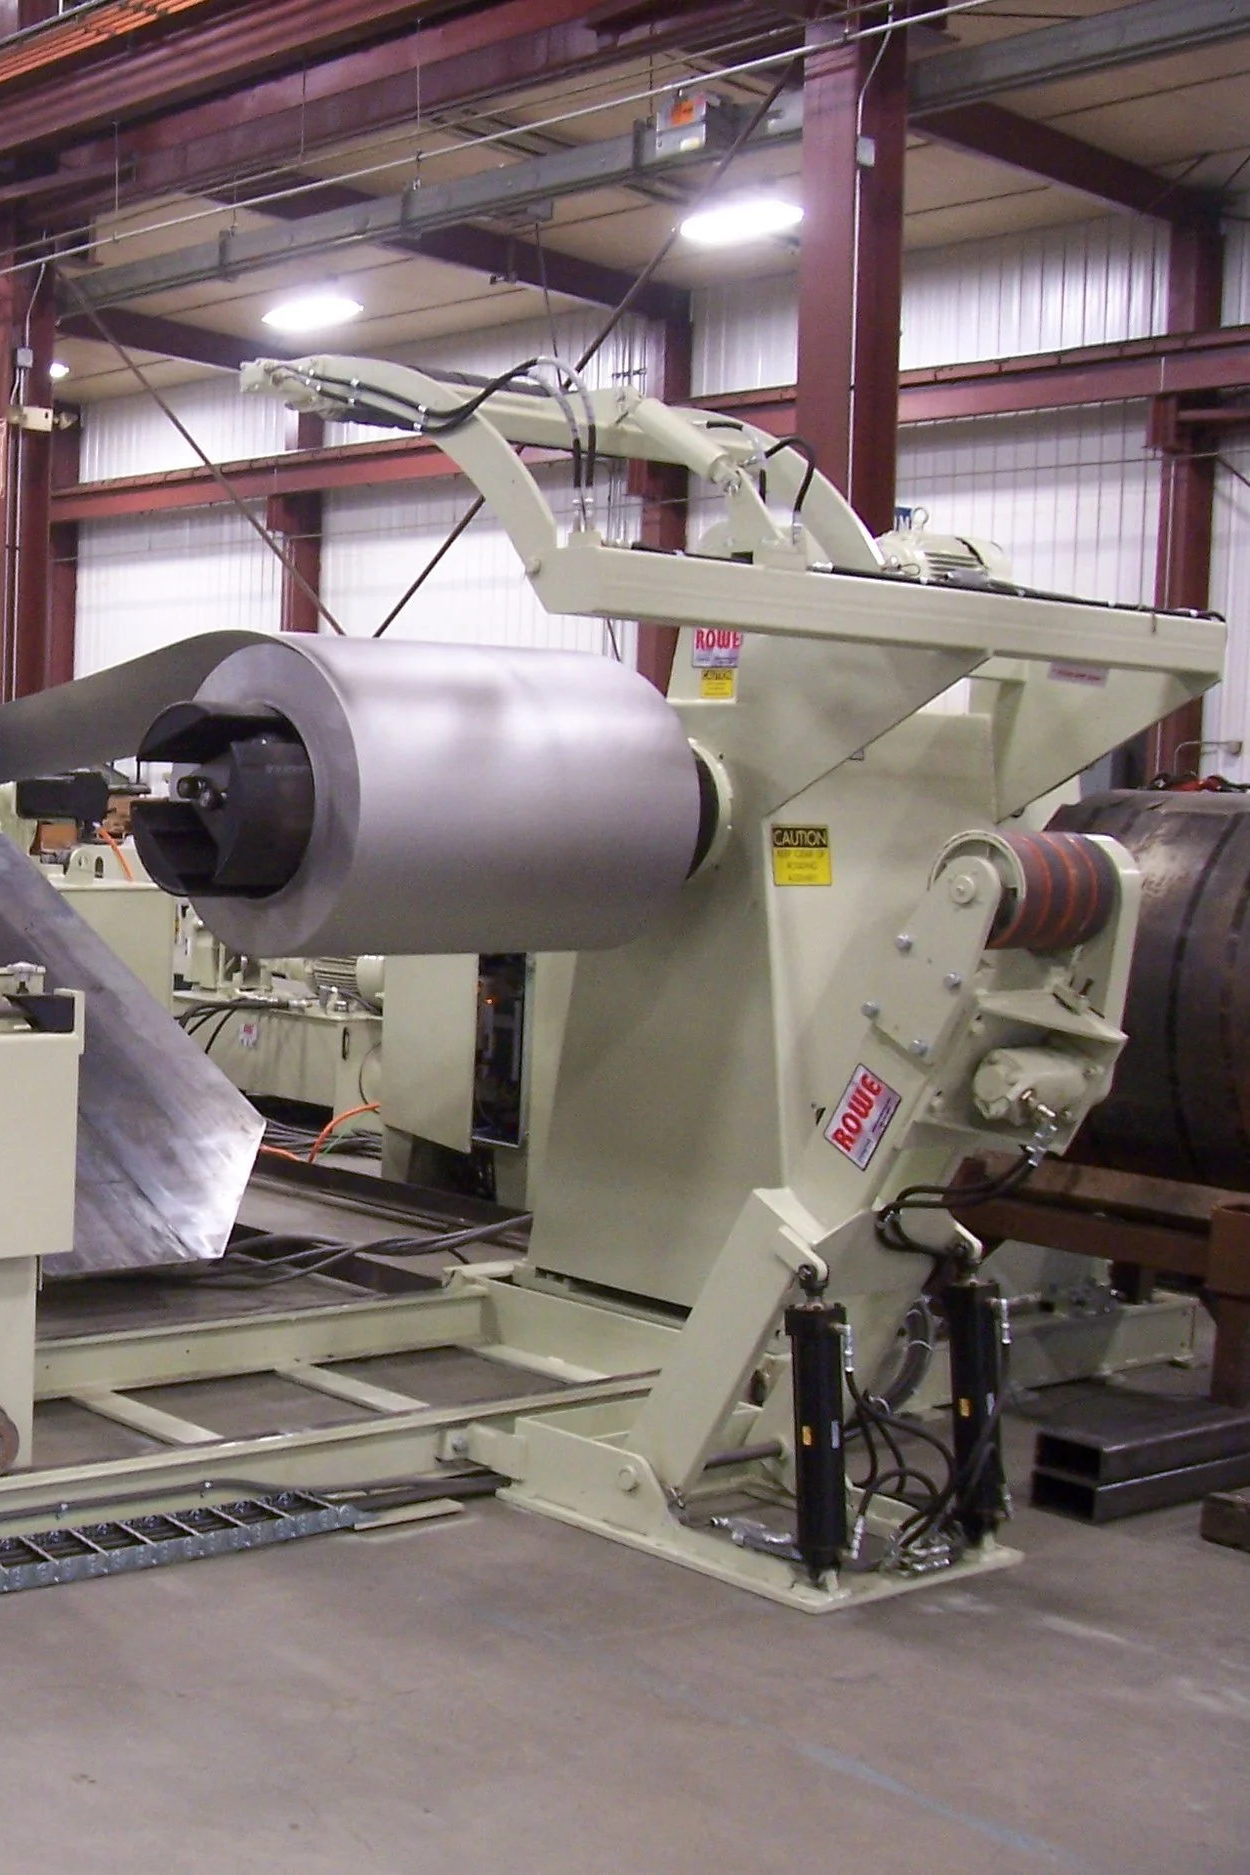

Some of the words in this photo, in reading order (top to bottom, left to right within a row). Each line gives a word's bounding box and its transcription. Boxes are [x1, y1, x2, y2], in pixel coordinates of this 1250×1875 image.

[695, 629, 741, 649] ROWE
[773, 830, 827, 846] CAUTION
[831, 1073, 883, 1152] ROWE
